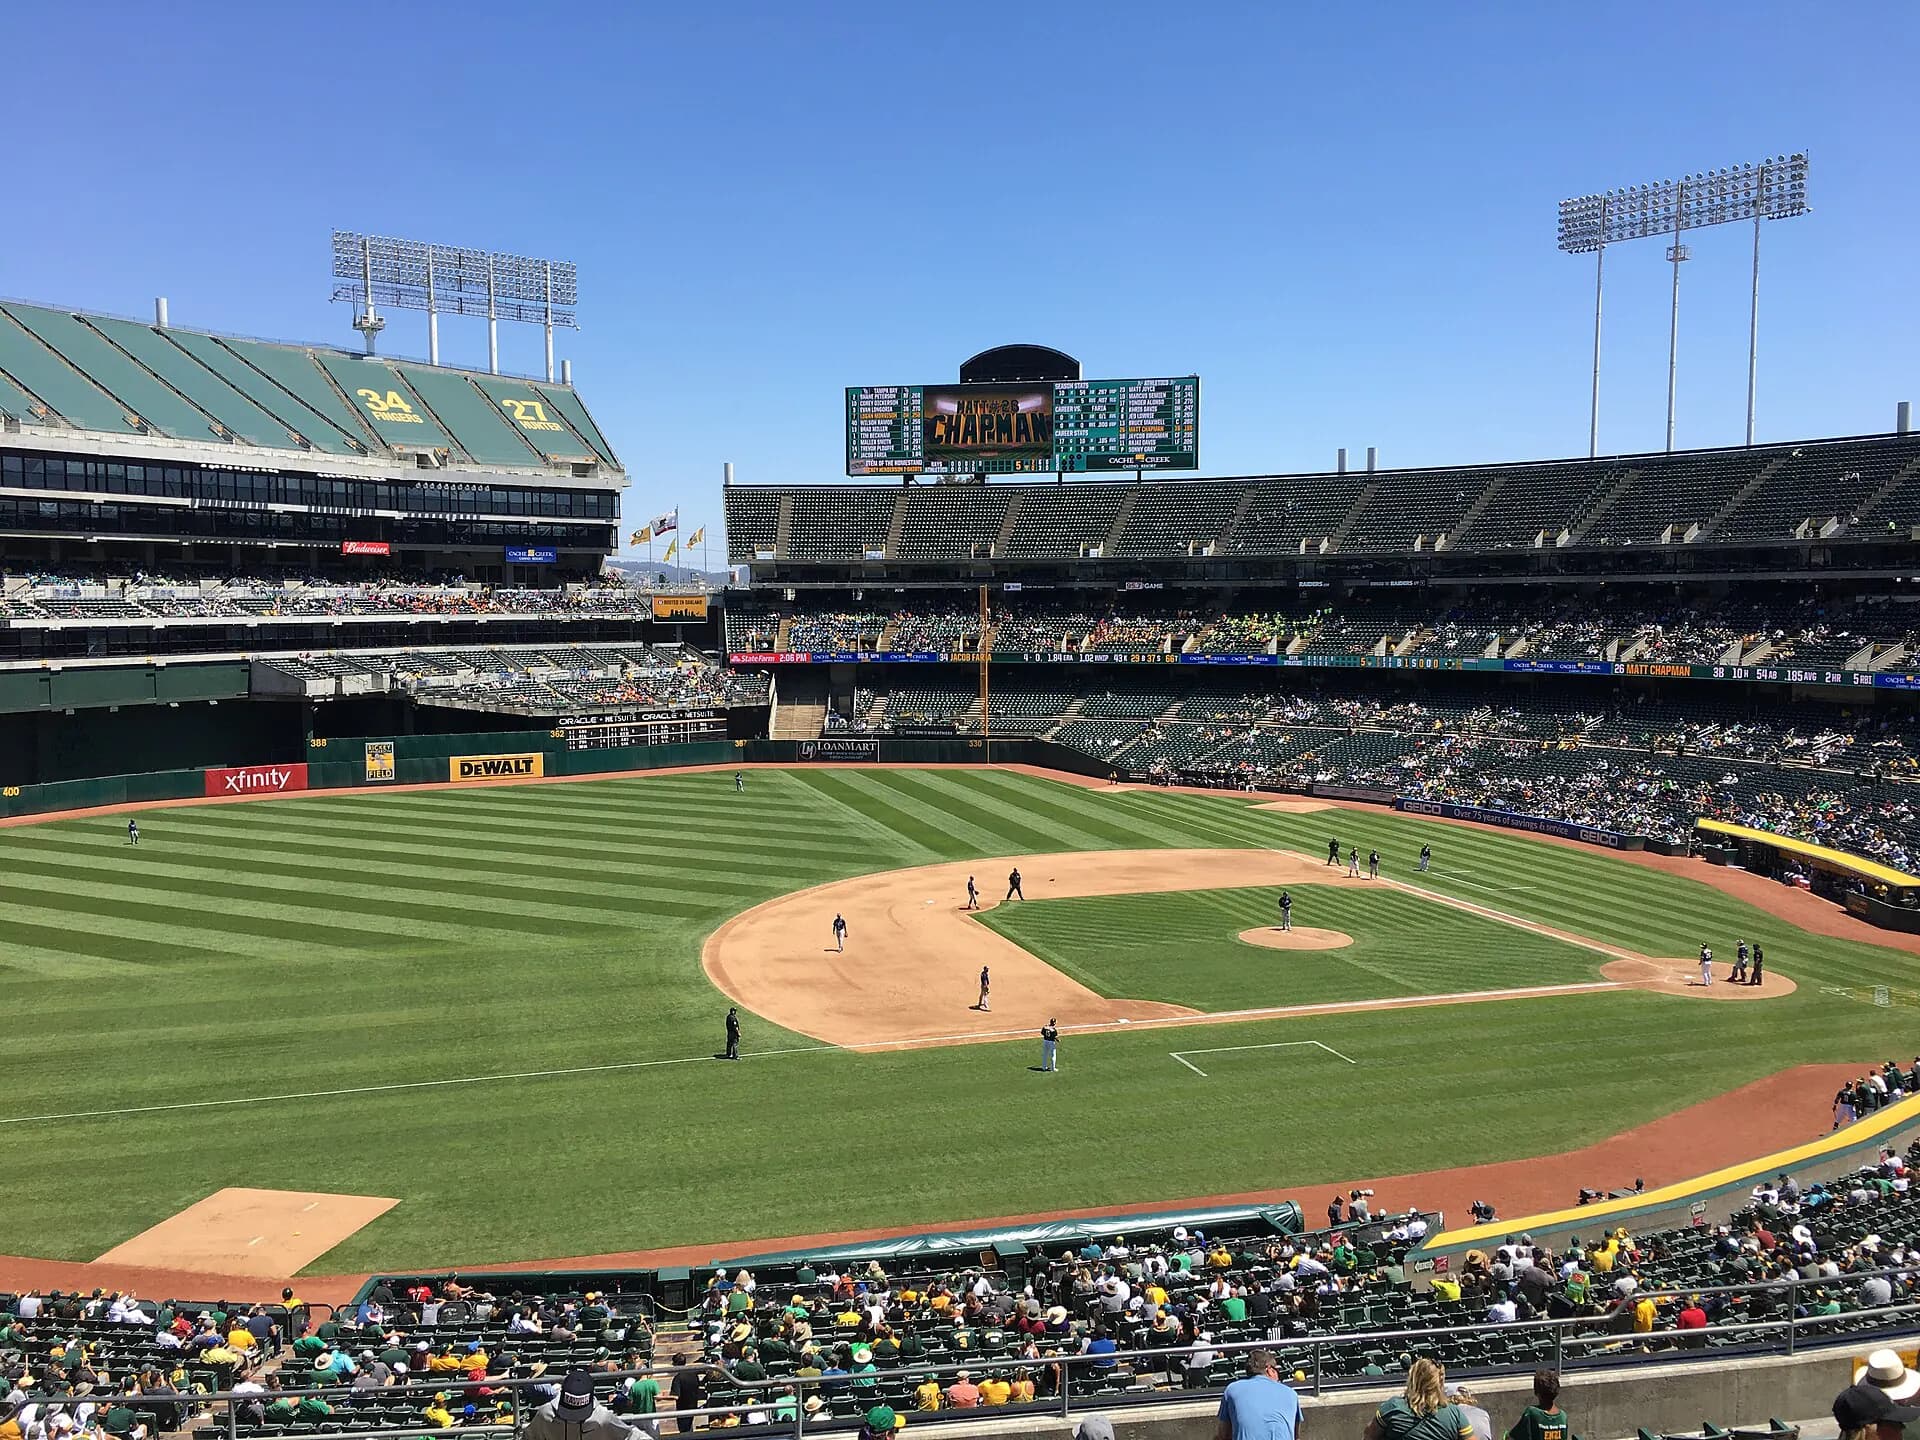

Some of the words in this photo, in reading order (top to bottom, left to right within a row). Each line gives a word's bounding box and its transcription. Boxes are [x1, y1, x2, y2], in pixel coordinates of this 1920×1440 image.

[357, 388, 412, 413] 34
[502, 399, 548, 421] 27
[372, 412, 424, 423] FINGERS
[519, 420, 564, 431] HUNTER
[928, 414, 1048, 444] CHAPMAN
[346, 542, 389, 554] Budweiser
[950, 653, 970, 661] JACOB
[1080, 654, 1093, 662] 1.02
[1614, 664, 1624, 673] 26
[1626, 664, 1648, 675] MATT
[1650, 665, 1690, 676] CHAPMAN
[1784, 671, 1803, 681] .185
[1804, 672, 1817, 681] AVG
[1860, 675, 1872, 684] RBI
[550, 730, 564, 738] 362
[310, 739, 327, 748] 388
[225, 768, 291, 792] xfinity
[3, 787, 20, 797] 400
[1404, 801, 1441, 815] GEICO
[1454, 808, 1471, 818] Over
[1473, 811, 1482, 820] 75
[1483, 813, 1501, 823] years
[1502, 816, 1510, 824] of
[1511, 820, 1538, 831] savings
[1545, 824, 1568, 835] service
[1580, 829, 1618, 846] GEICO
